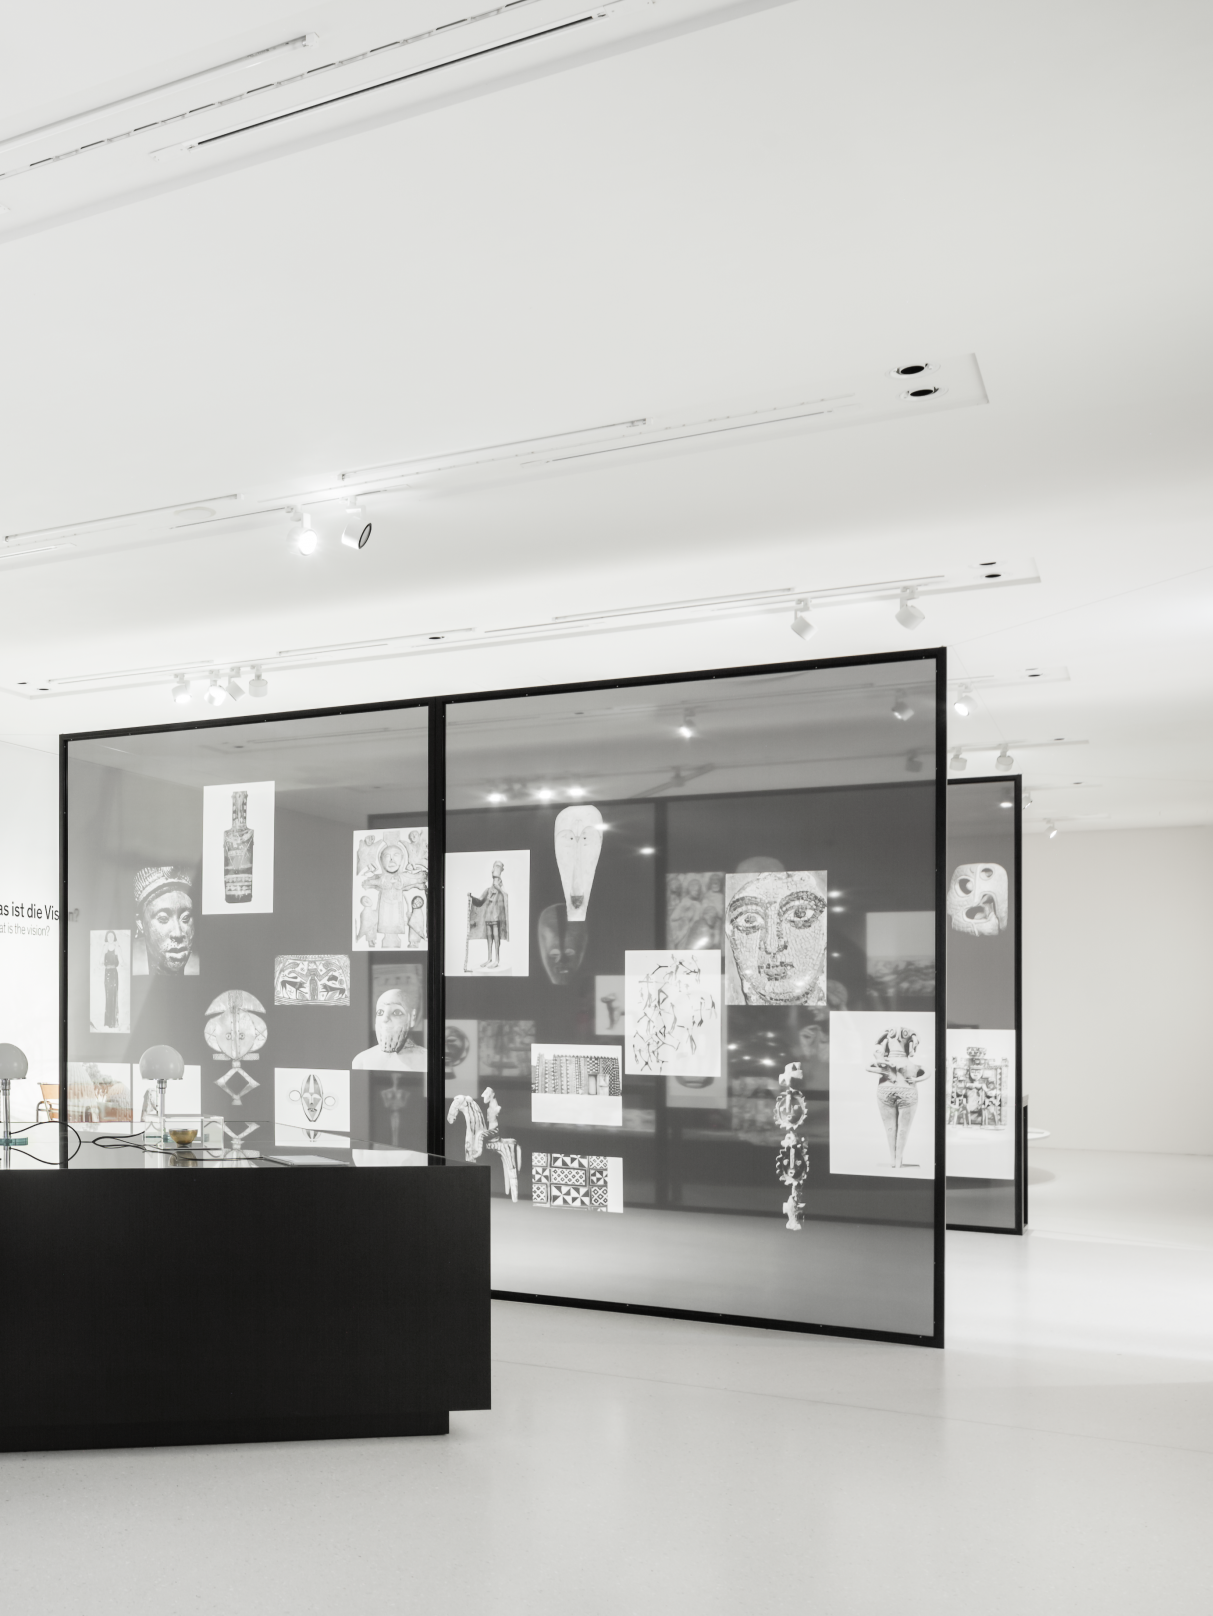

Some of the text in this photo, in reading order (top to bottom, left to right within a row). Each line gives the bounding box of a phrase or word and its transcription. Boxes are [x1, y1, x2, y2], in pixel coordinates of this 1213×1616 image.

[11, 901, 25, 918] ist
[27, 903, 43, 919] die
[7, 922, 14, 934] is
[14, 923, 26, 935] the
[27, 924, 51, 936] vision?
